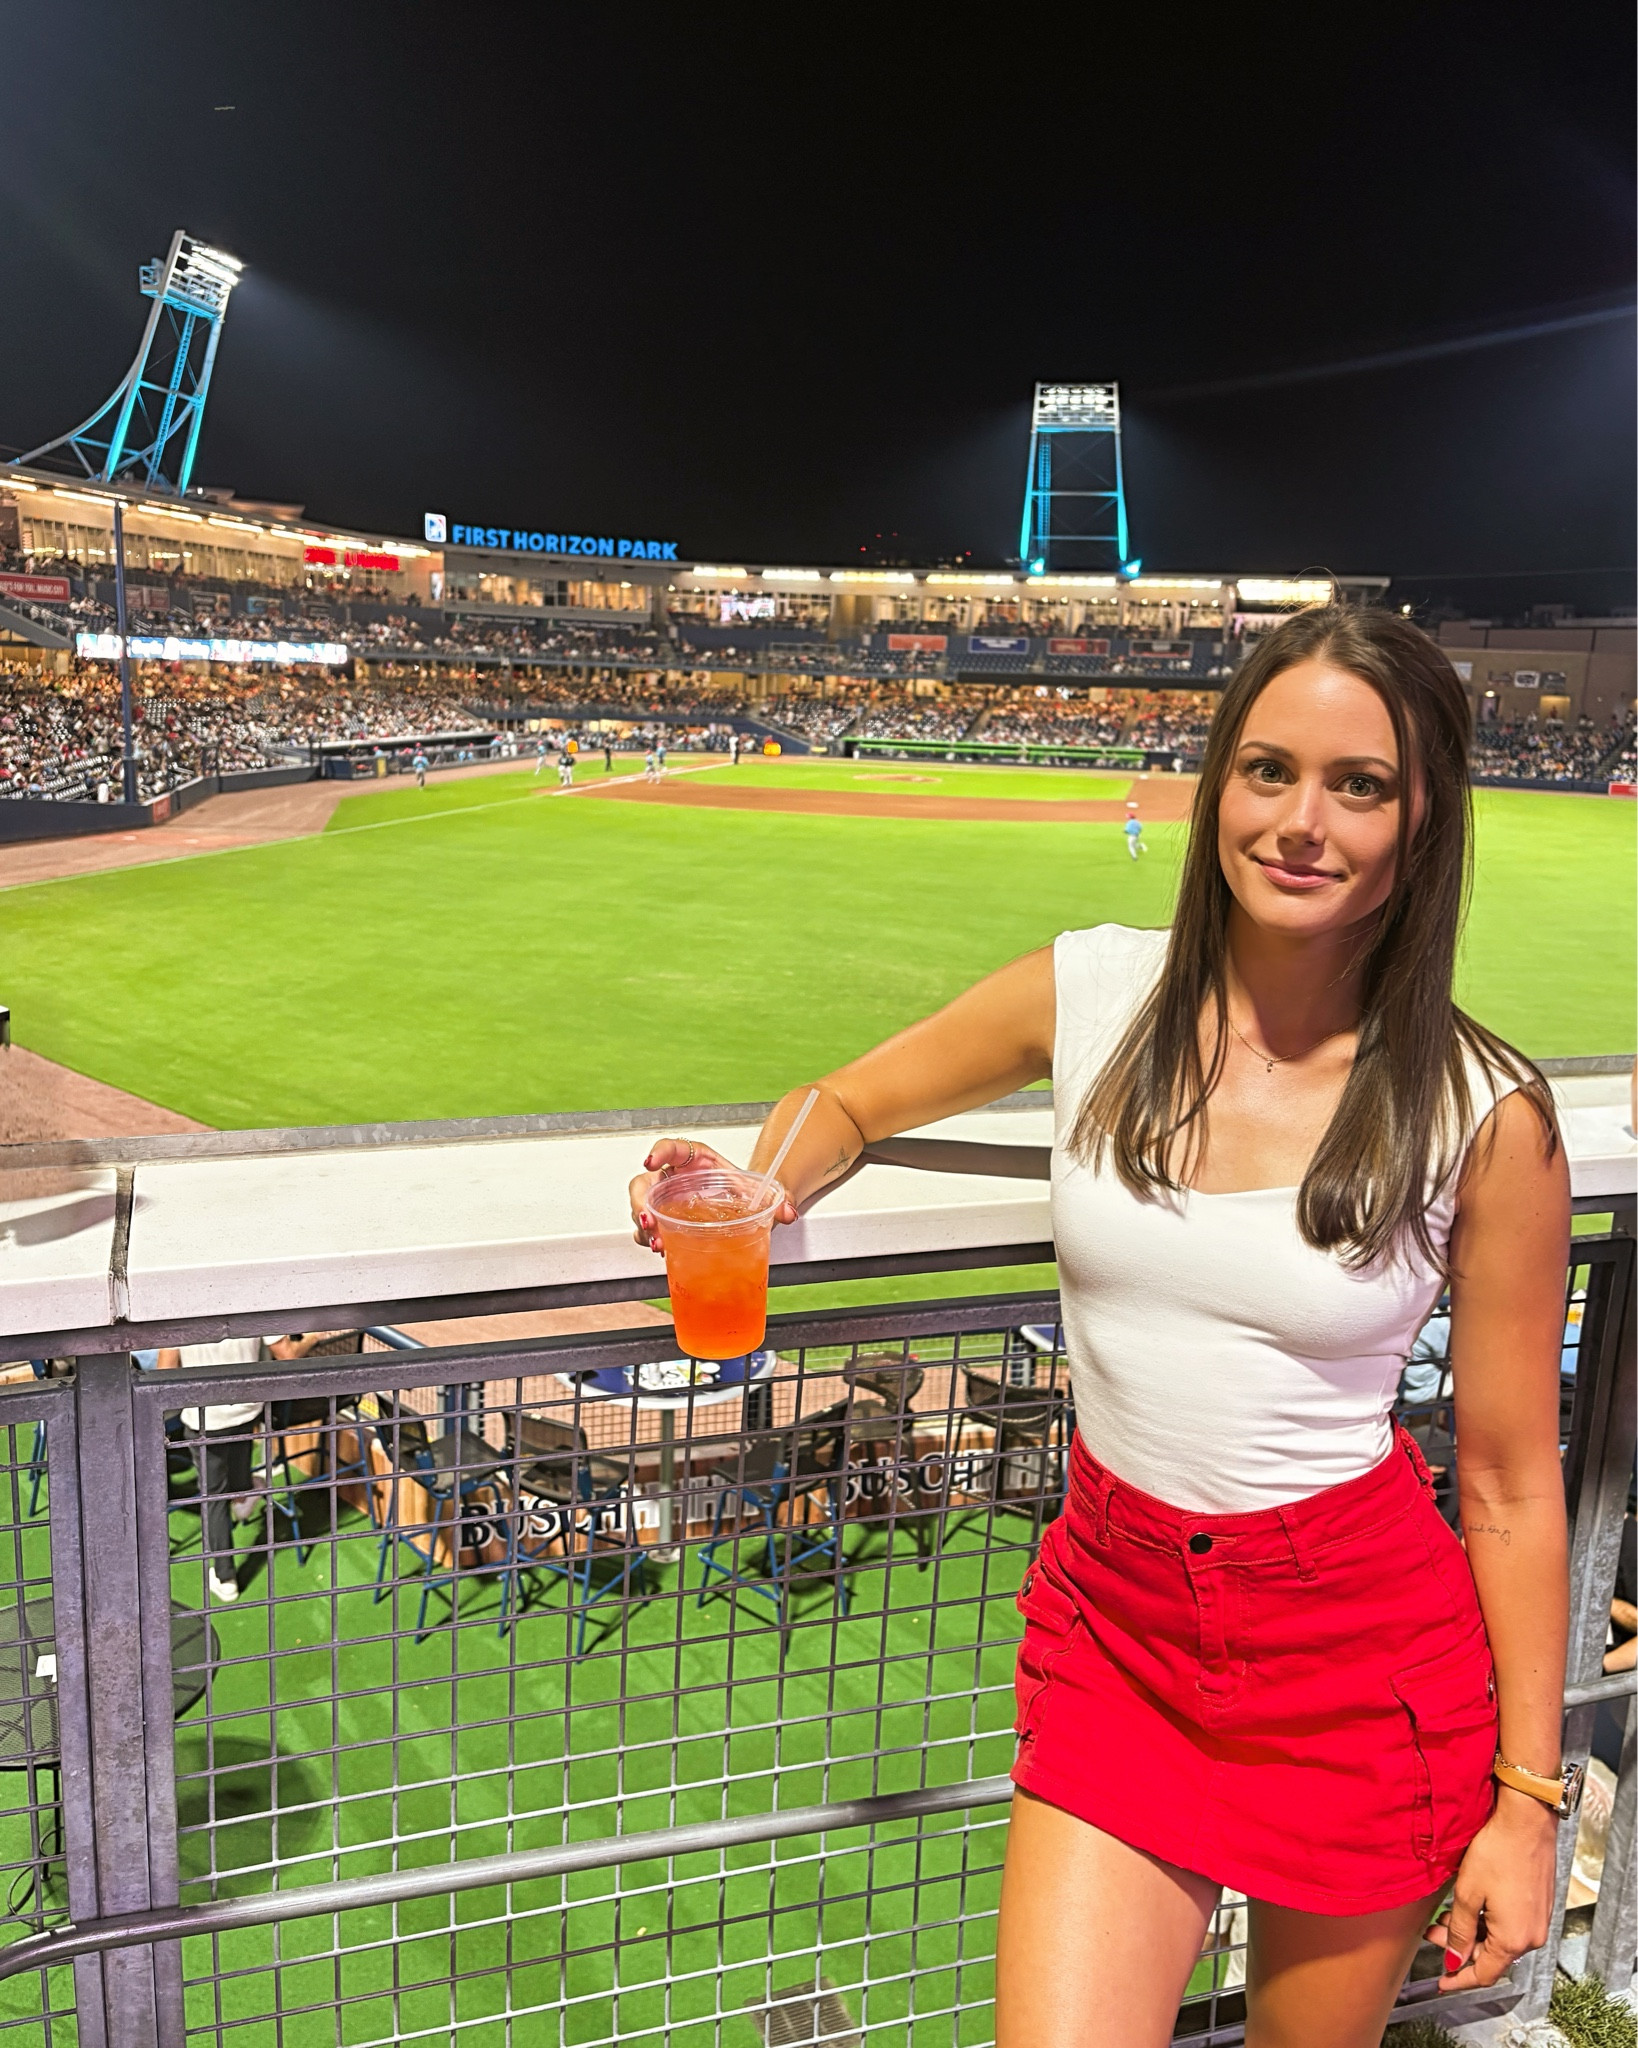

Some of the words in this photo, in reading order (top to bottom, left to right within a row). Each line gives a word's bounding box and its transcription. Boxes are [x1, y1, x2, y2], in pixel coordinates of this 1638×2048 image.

[452, 524, 510, 549] FIRST
[513, 530, 614, 557] HORIZON
[617, 539, 678, 560] PARK
